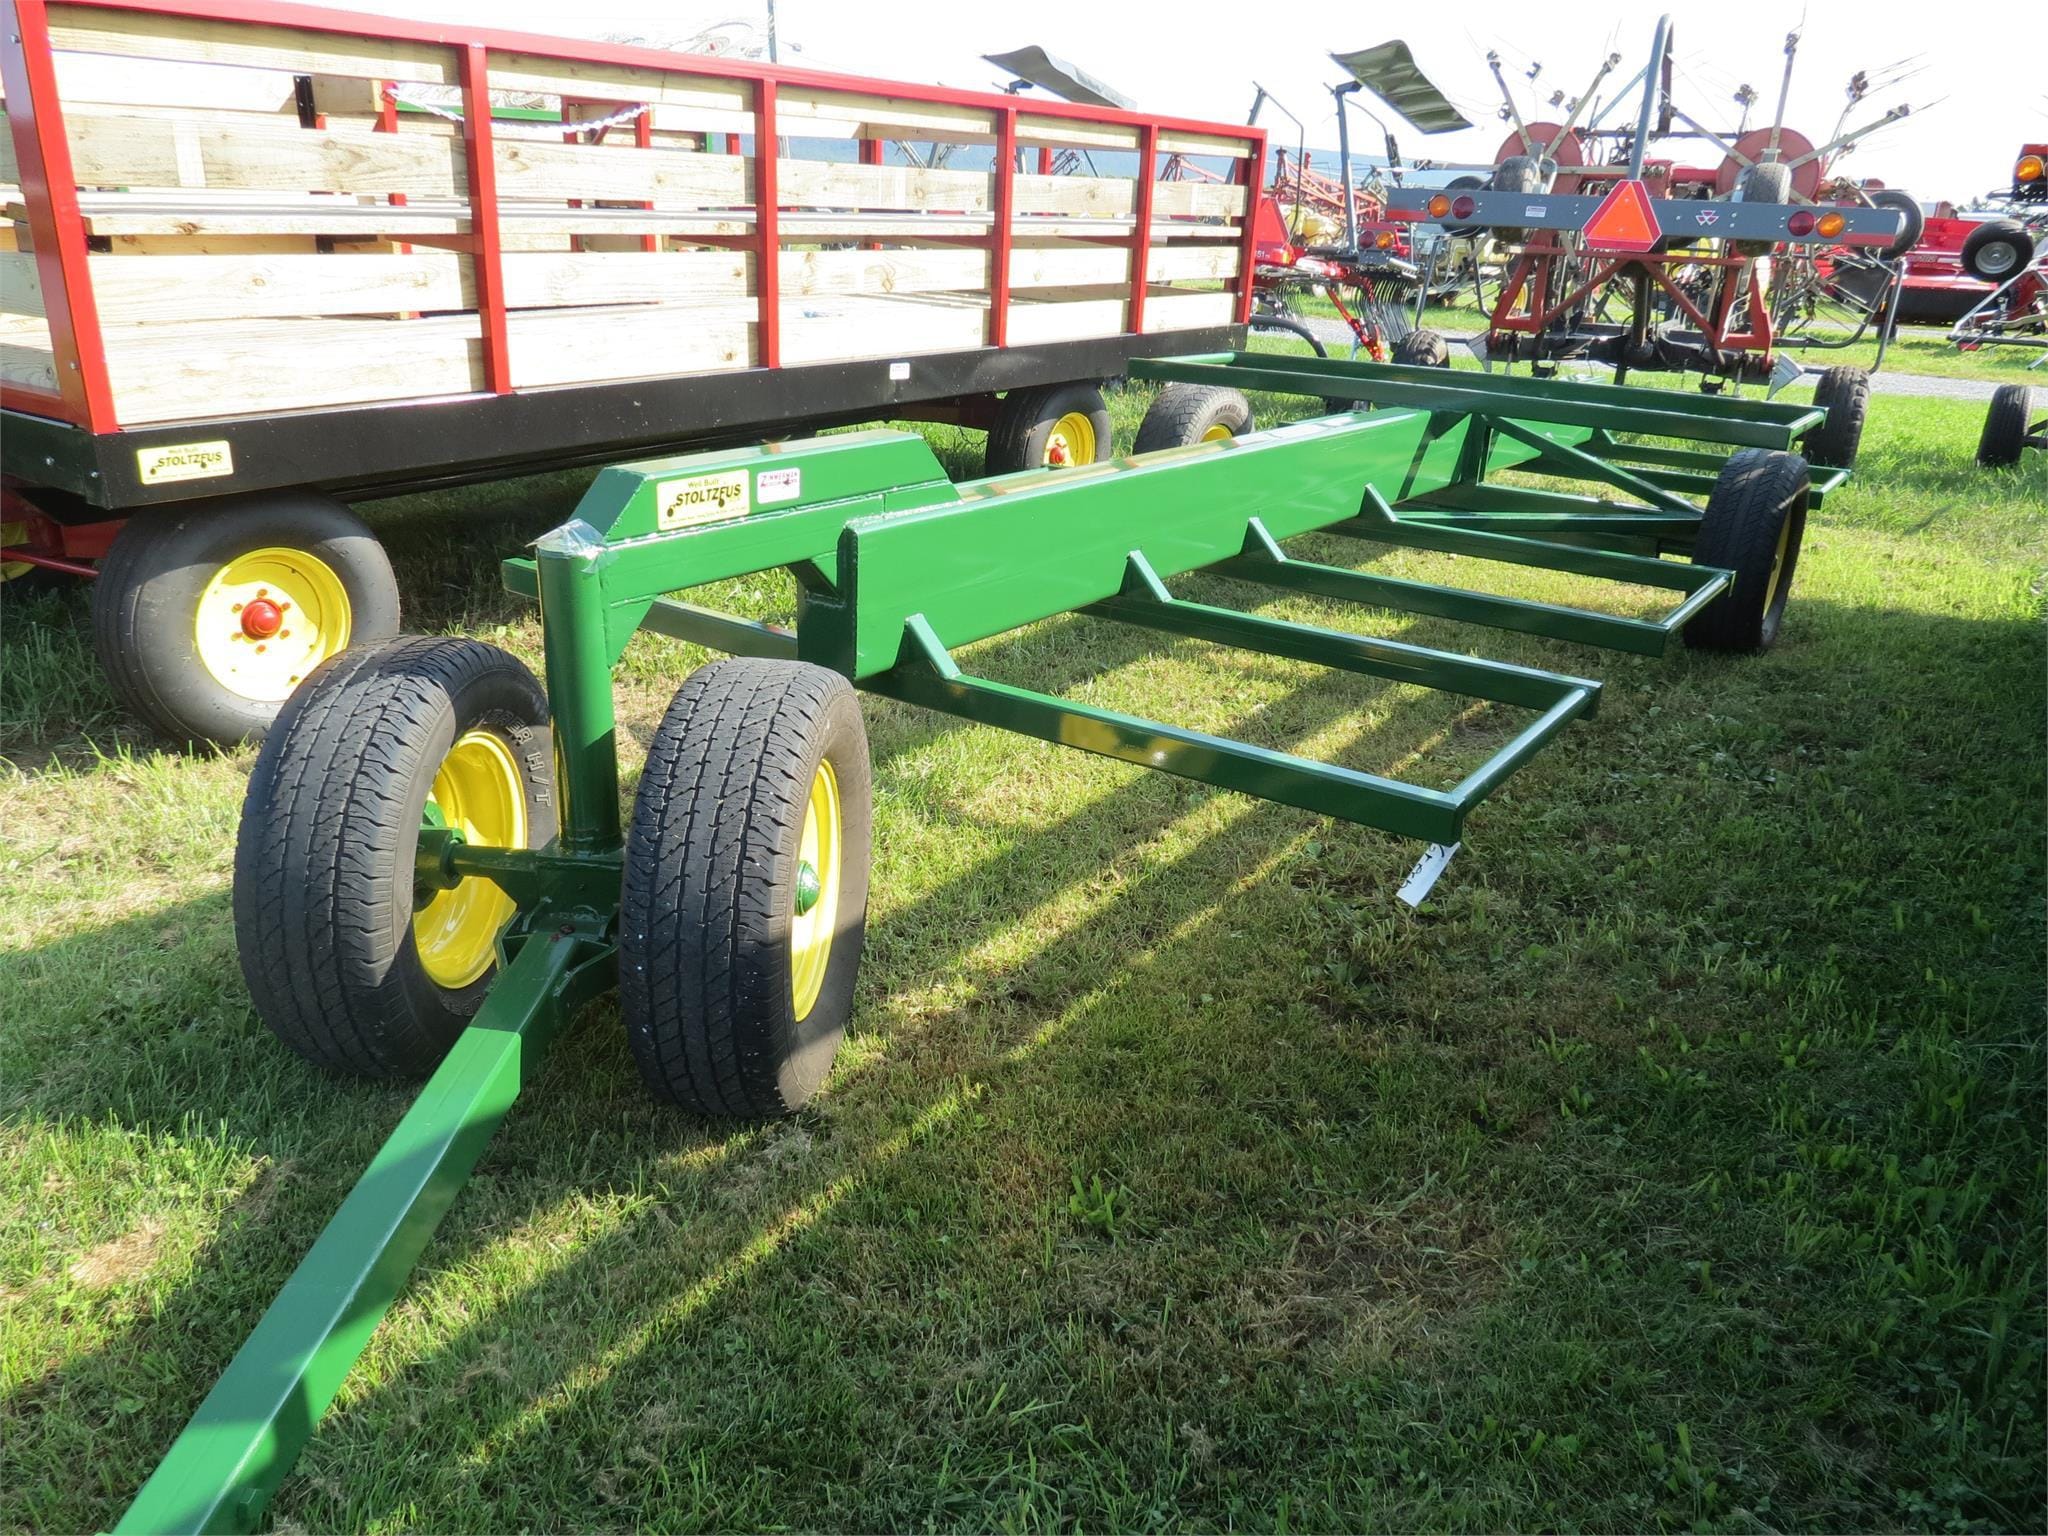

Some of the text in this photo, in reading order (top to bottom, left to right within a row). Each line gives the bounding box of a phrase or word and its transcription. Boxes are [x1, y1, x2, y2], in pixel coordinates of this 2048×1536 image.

[158, 451, 223, 468] STOLTZFUS
[675, 484, 741, 507] STOLTZFUS
[526, 751, 552, 807] H/T
